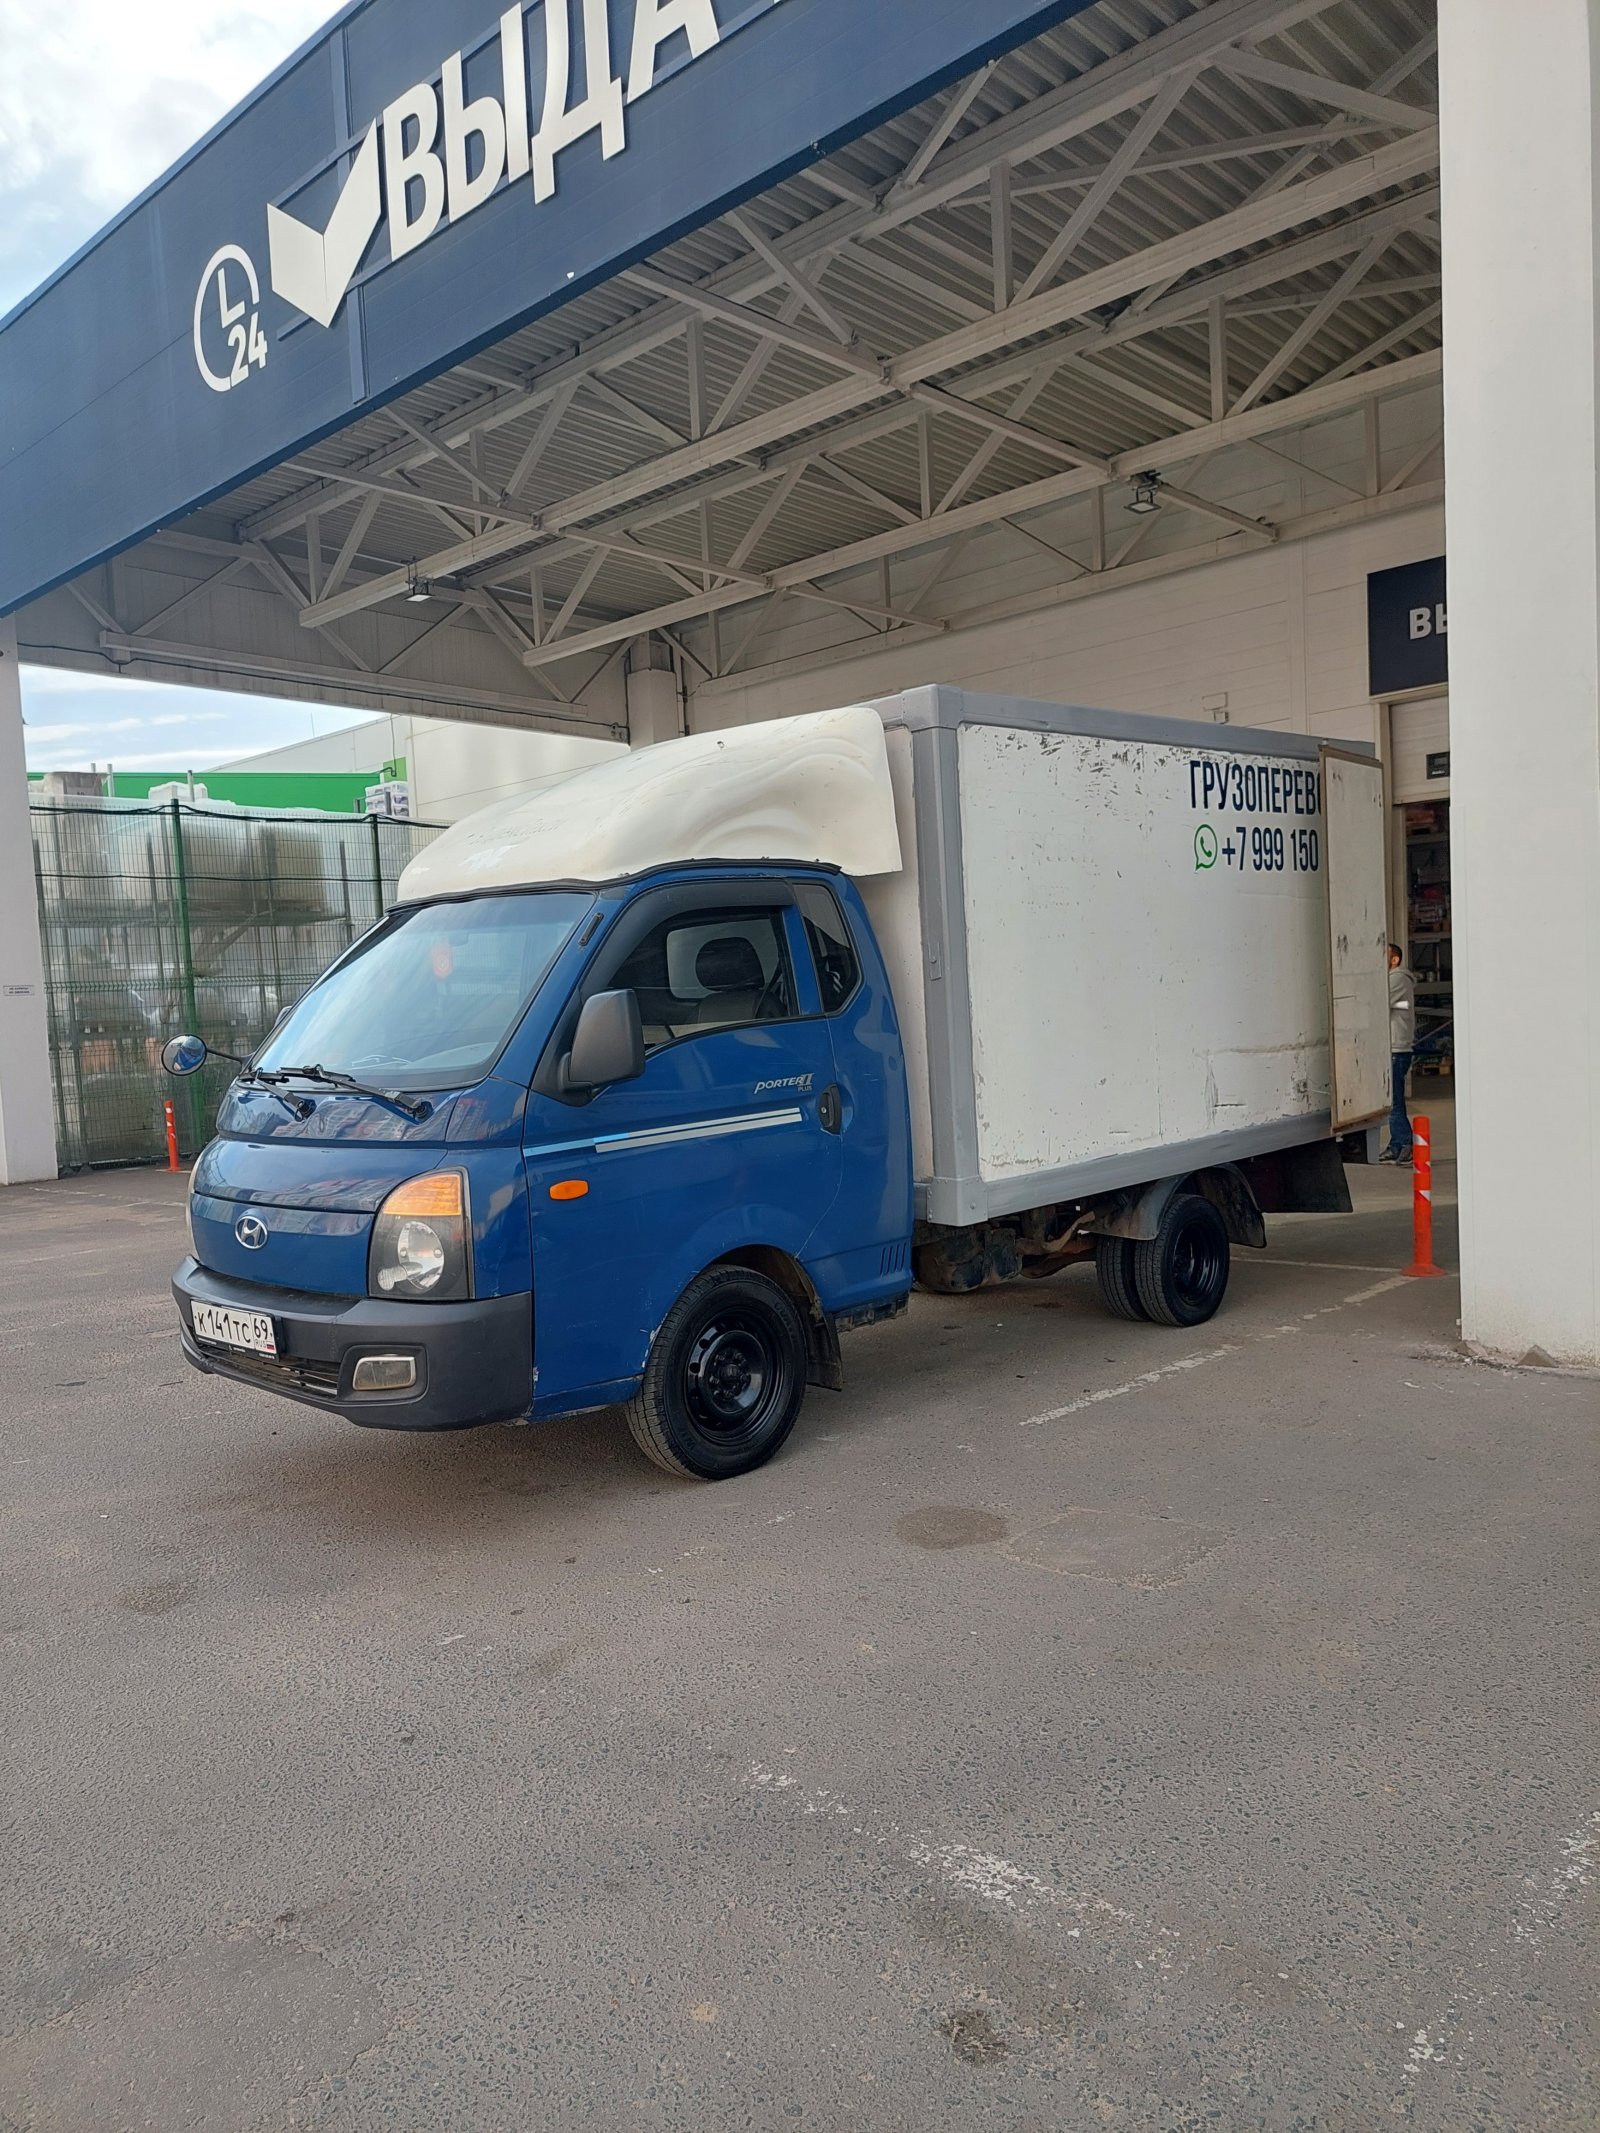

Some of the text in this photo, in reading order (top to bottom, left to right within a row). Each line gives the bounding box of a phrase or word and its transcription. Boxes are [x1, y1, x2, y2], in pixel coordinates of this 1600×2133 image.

[228, 312, 268, 387] 24
[1222, 827, 1319, 872] +7 999 150
[253, 1317, 268, 1340] 69
